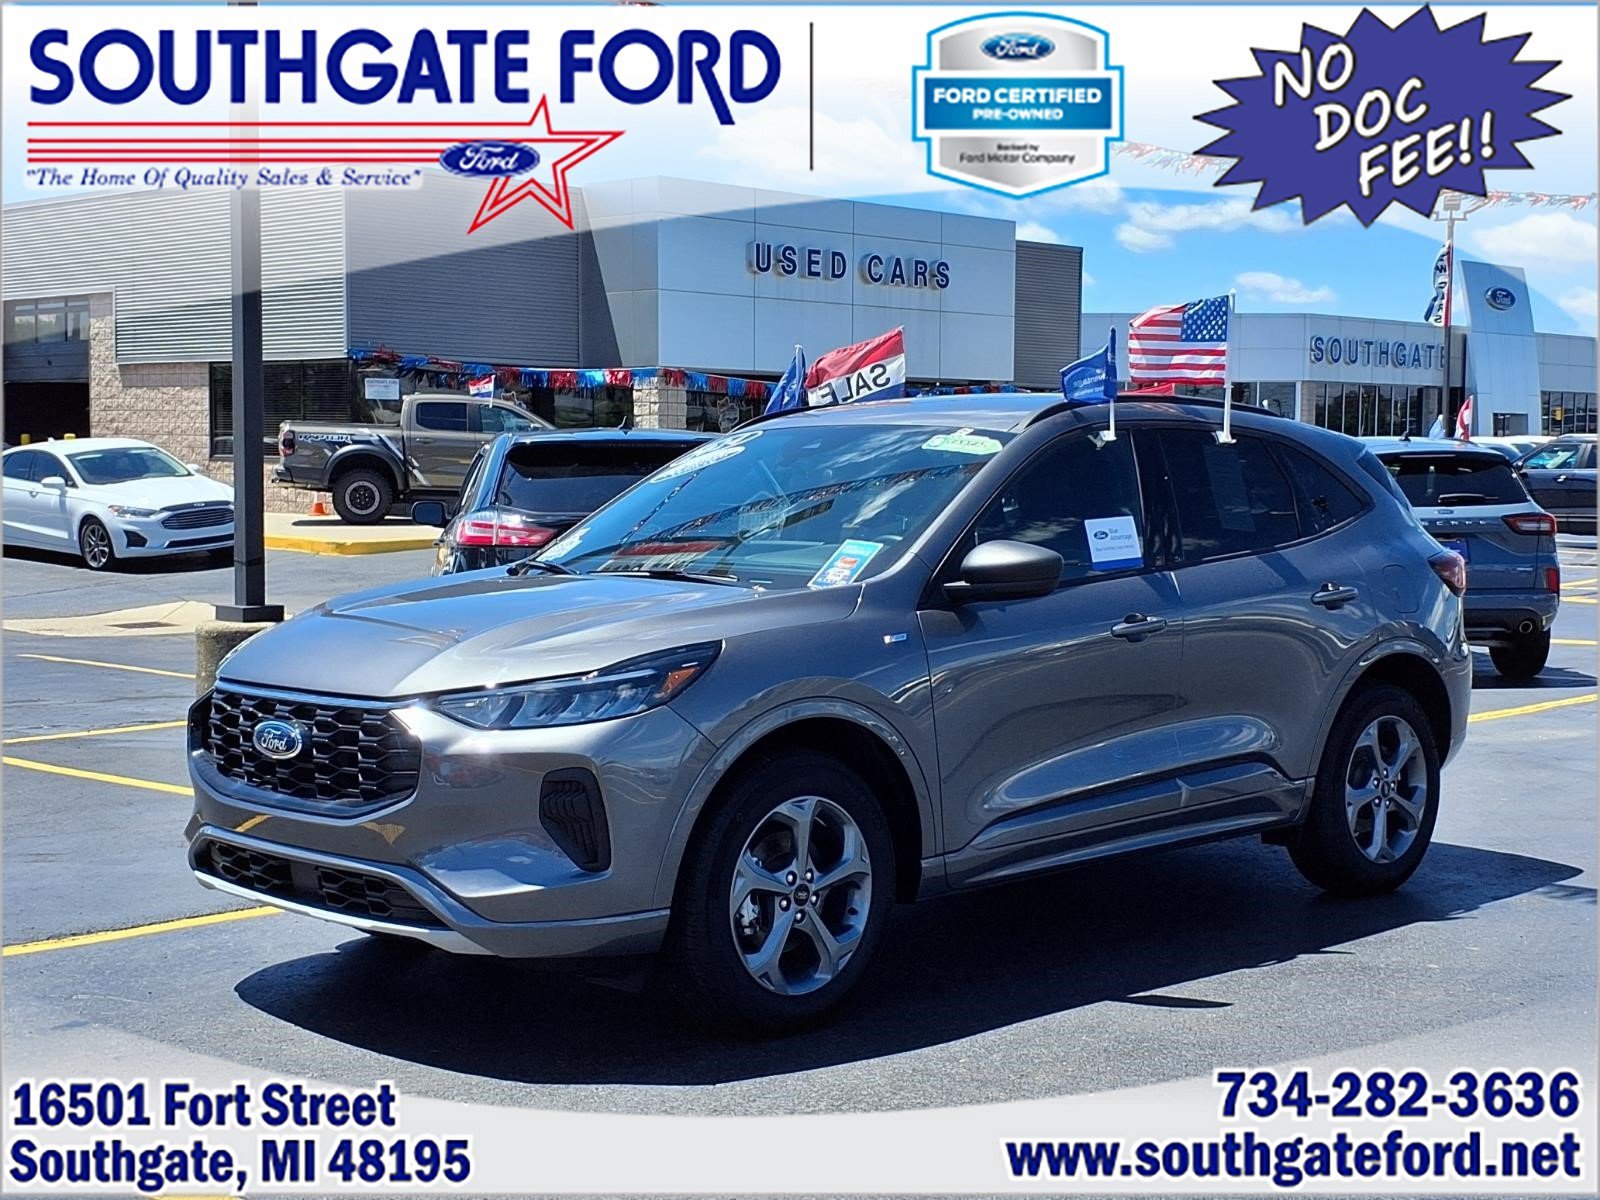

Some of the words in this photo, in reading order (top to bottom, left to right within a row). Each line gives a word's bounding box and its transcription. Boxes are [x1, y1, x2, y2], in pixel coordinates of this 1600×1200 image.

[753, 242, 847, 280] USED
[867, 253, 951, 290] CARS
[260, 728, 288, 751] Ford
